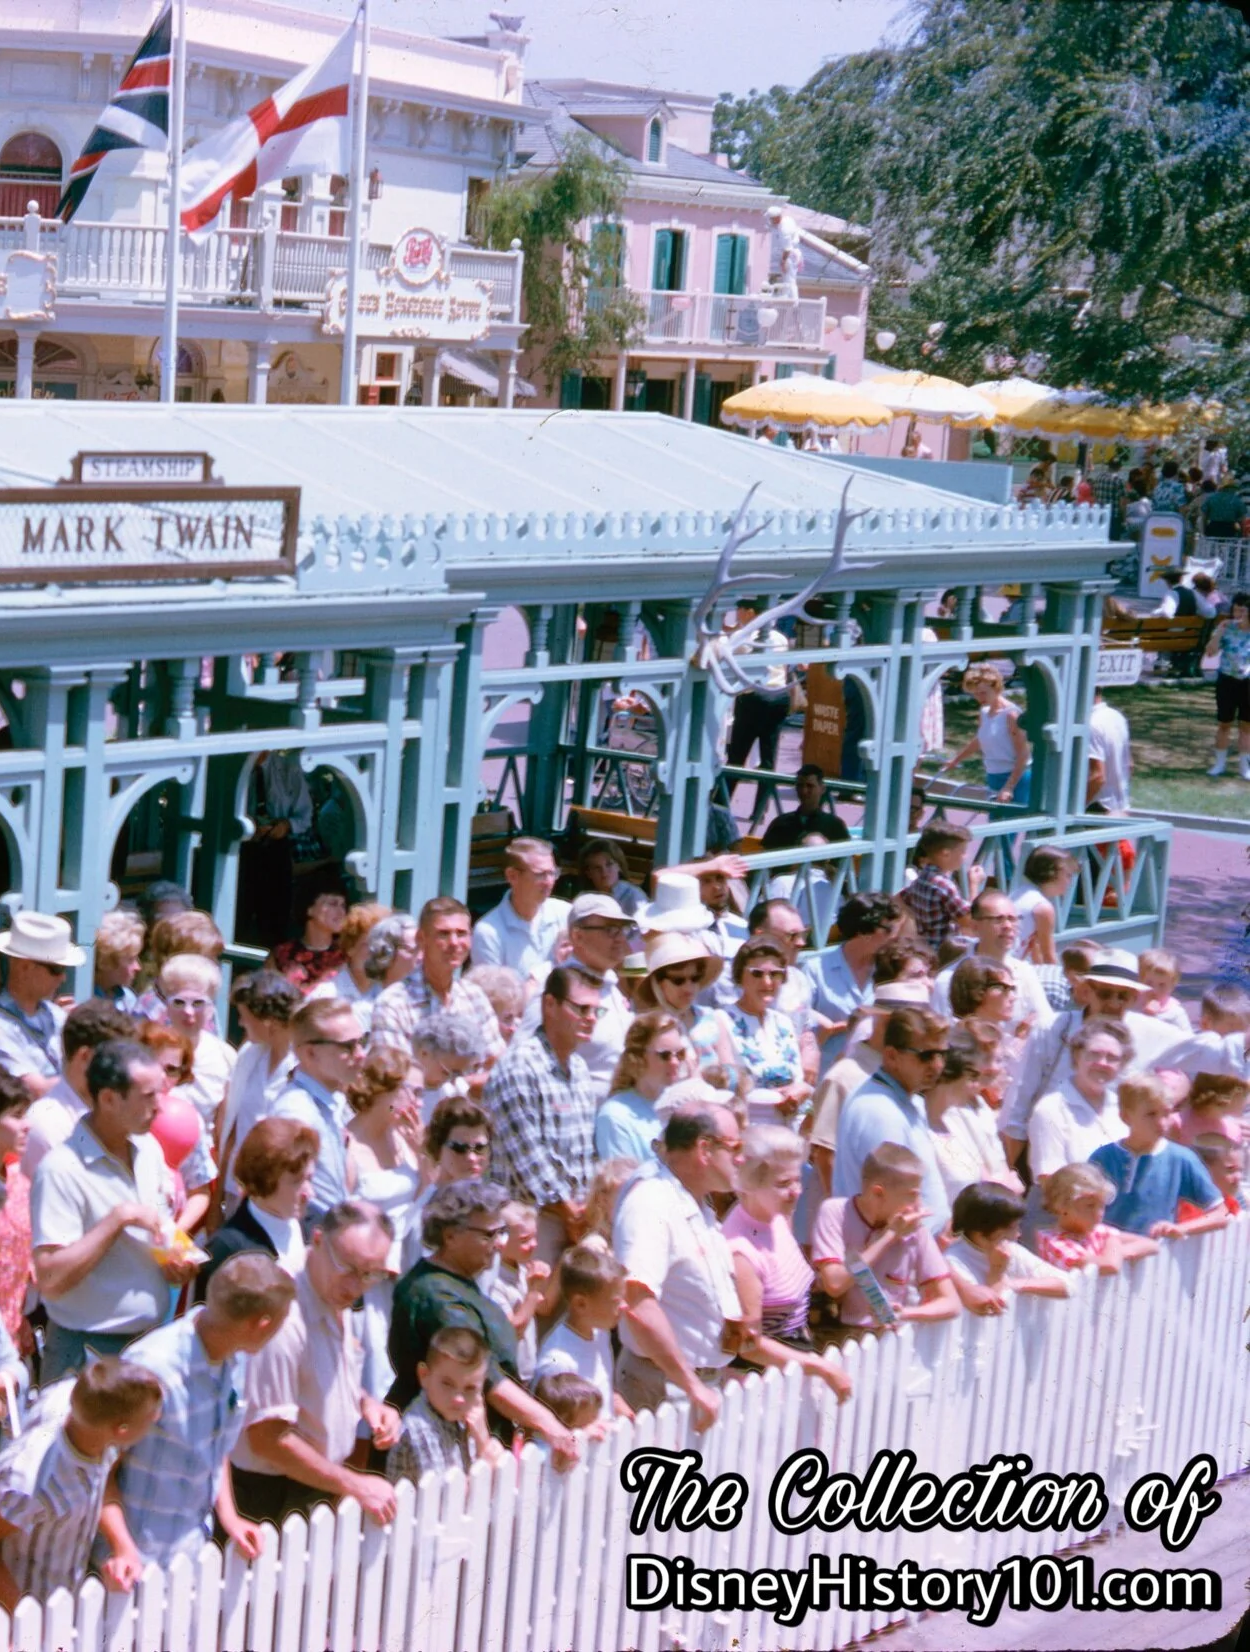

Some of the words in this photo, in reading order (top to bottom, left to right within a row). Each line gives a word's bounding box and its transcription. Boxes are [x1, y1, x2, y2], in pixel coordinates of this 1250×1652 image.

[90, 458, 196, 477] STEAMSHIP
[22, 515, 126, 554] MARK
[151, 513, 255, 551] TWAIN
[1097, 654, 1137, 673] EXIT
